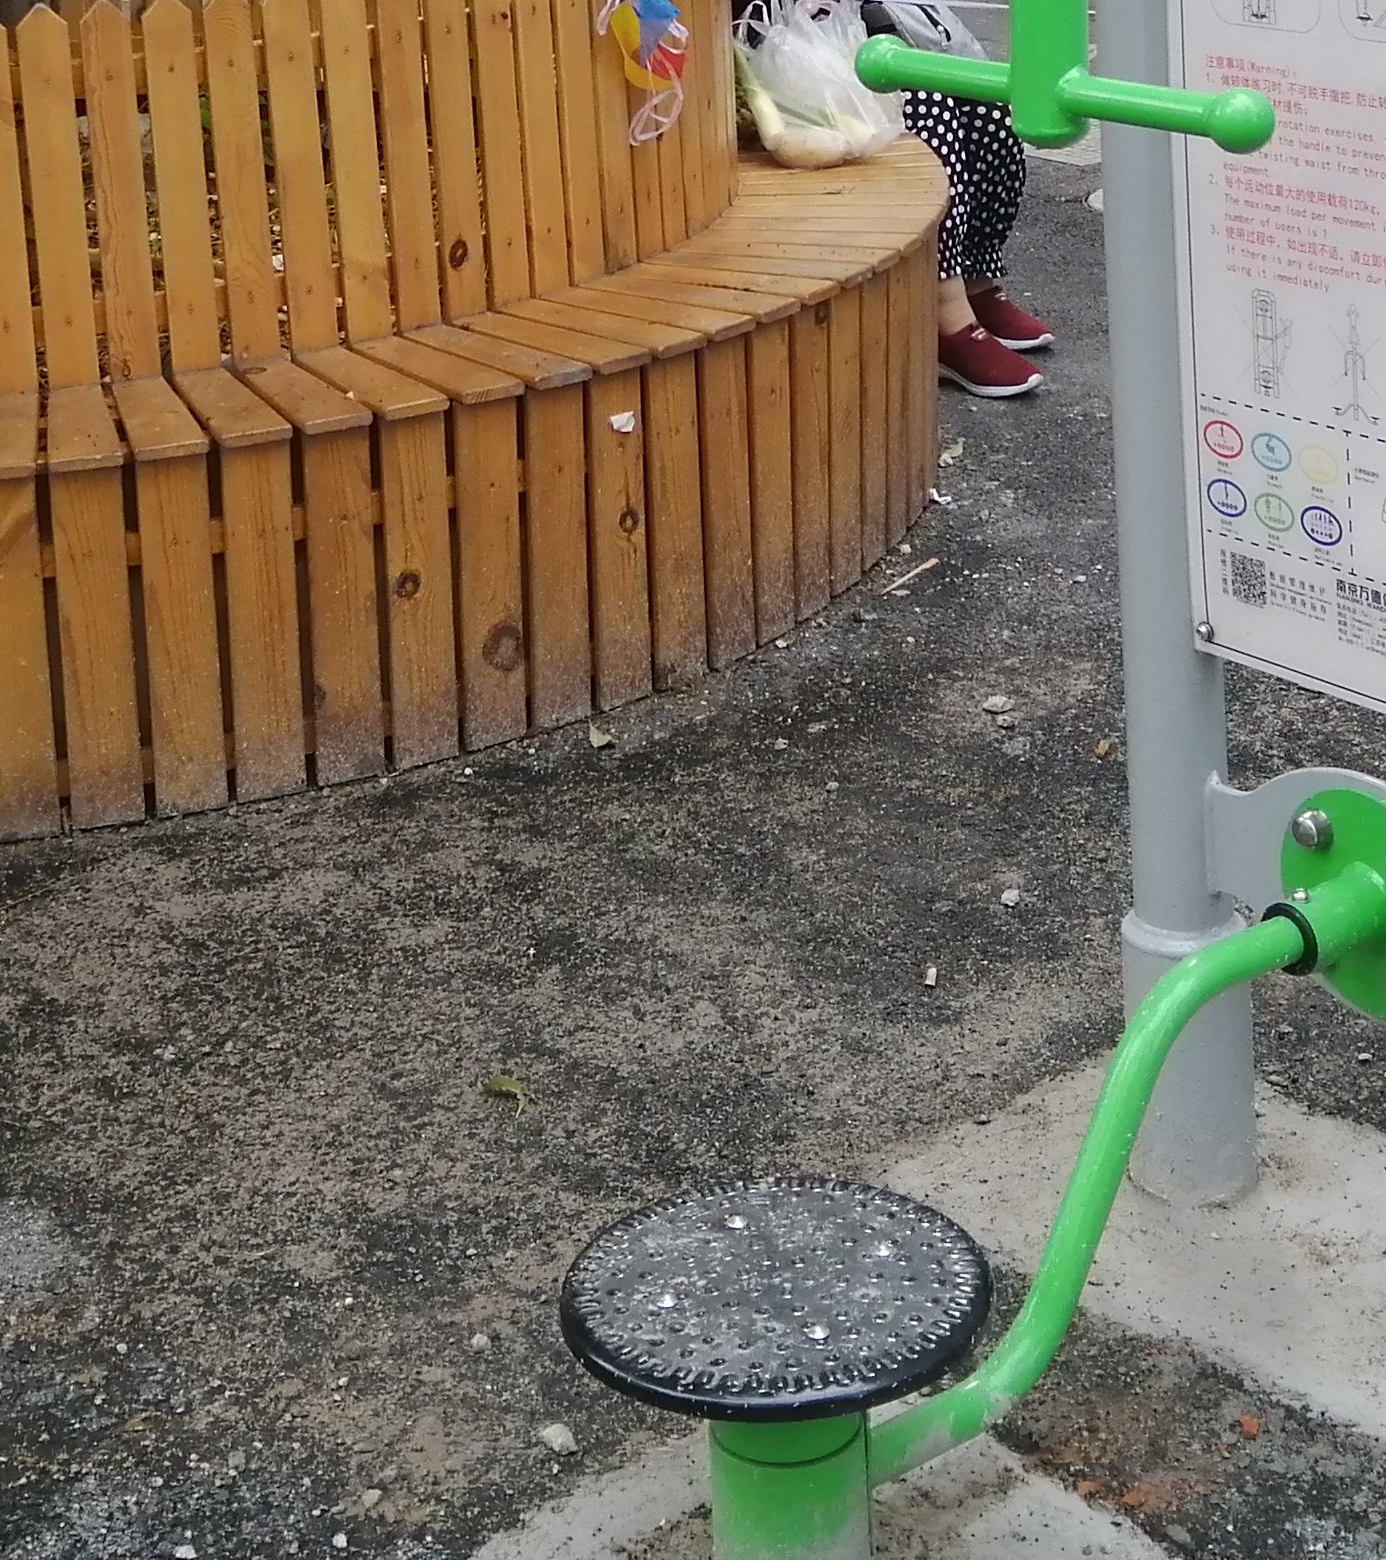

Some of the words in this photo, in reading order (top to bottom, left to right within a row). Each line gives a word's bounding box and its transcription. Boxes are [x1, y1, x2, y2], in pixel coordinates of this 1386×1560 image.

[1278, 119, 1320, 133] rotation
[1279, 136, 1294, 148] the
[1299, 138, 1331, 153] handle
[1336, 145, 1347, 156] to
[1223, 162, 1269, 177] equipment
[1259, 151, 1299, 167] twisting
[1305, 156, 1331, 170] waist
[1337, 162, 1359, 175] from
[1225, 194, 1239, 205] The
[1244, 198, 1281, 212] maximum
[1287, 205, 1307, 218] load
[1312, 210, 1326, 222] per
[1332, 217, 1376, 232] movement
[1225, 212, 1254, 224] number
[1261, 218, 1270, 228] of
[1275, 222, 1302, 234] users
[1308, 226, 1317, 237] is
[1226, 244, 1236, 255] If
[1242, 248, 1267, 261] there
[1273, 253, 1282, 265] is
[1287, 258, 1302, 270] any
[1308, 261, 1361, 281] discomfort
[1226, 264, 1251, 277] using
[1257, 268, 1267, 279] it
